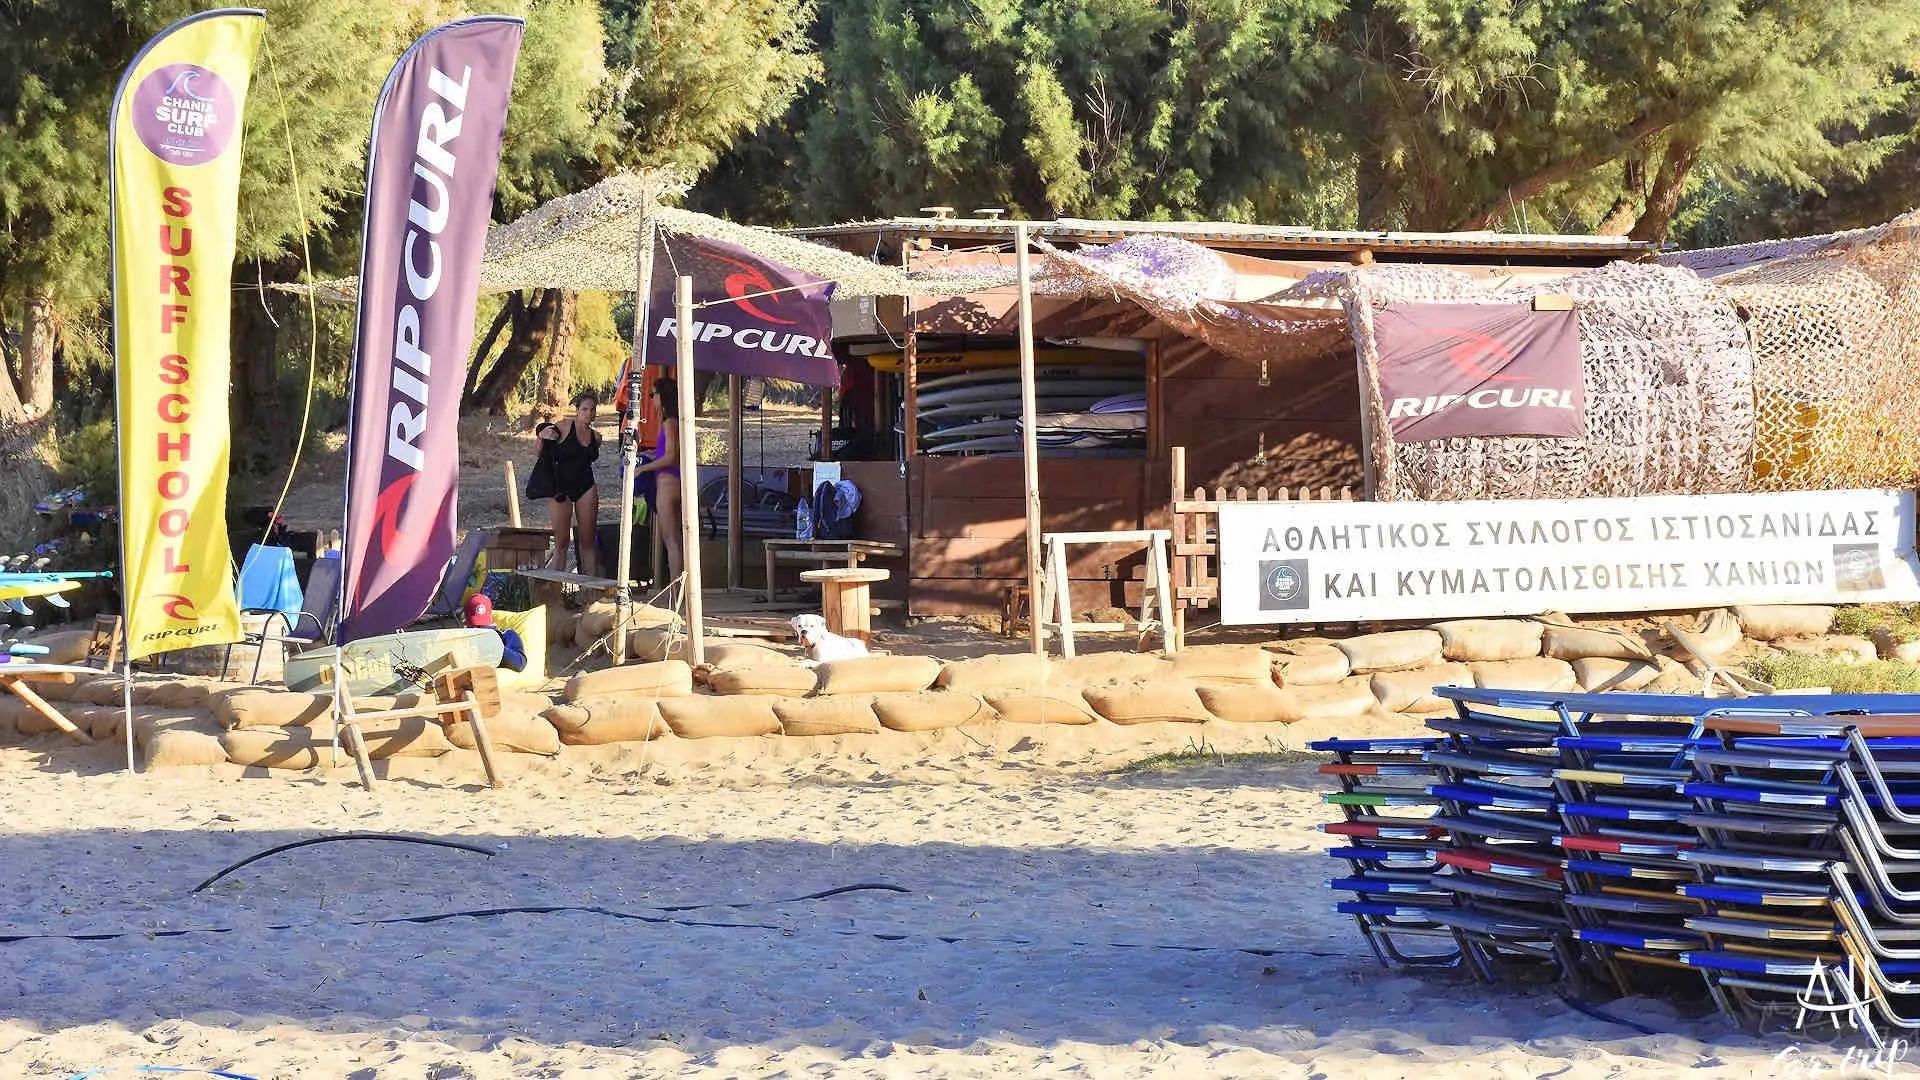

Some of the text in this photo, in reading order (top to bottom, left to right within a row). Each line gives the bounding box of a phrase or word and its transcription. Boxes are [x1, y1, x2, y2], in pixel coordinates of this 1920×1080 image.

[155, 105, 218, 128] SURF
[161, 96, 214, 113] CHANIA
[167, 122, 204, 137] CLUB
[159, 186, 193, 334] SURF
[388, 65, 472, 472] RIP CURL
[732, 327, 833, 360] CURL
[1388, 388, 1576, 419] RIP CURL
[156, 354, 191, 574] SCHOOL
[1262, 511, 1879, 552] ΑΘΛΗΤΙΚΟΣ ΣΥΛΛΟΓΟΣ ΙΣΤΙΟΣΑΝΙΔΑΣ
[1324, 572, 1377, 599] ΚΑΙ
[1398, 563, 1687, 597] ΚΥΜΑΤΟΛΙΣΘΙΣΗΣ
[1704, 560, 1824, 587] ΧΑΝΙΩΝ
[143, 623, 218, 642] RIP CURL
